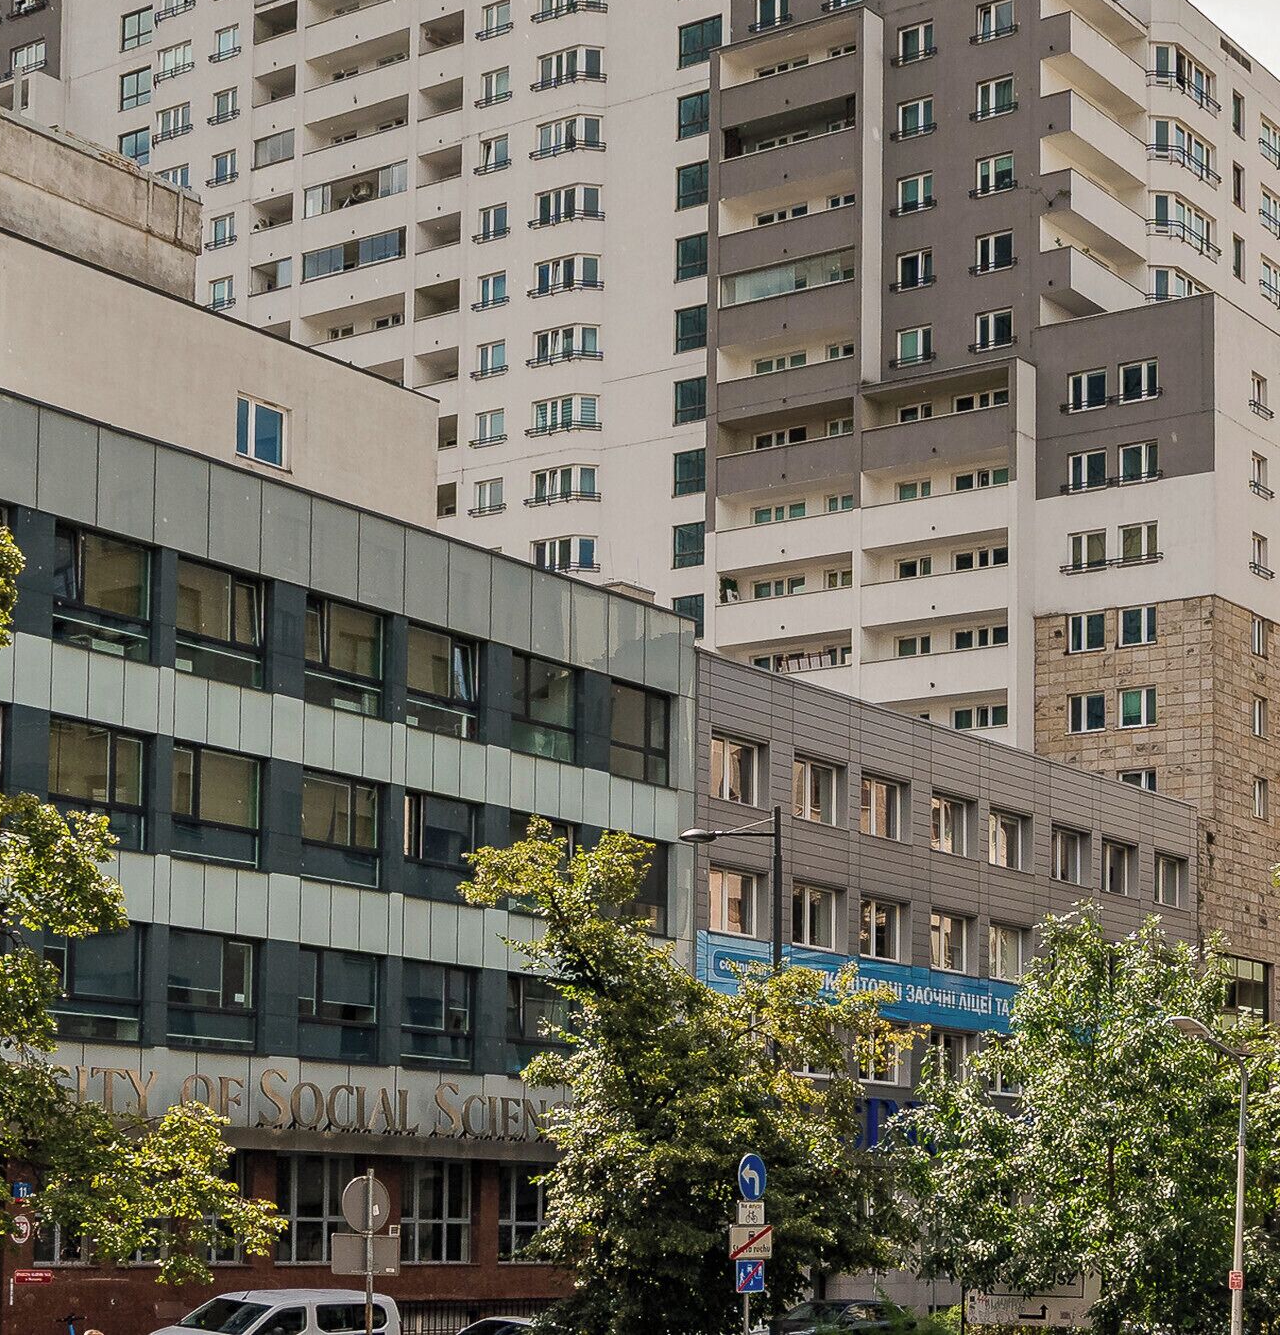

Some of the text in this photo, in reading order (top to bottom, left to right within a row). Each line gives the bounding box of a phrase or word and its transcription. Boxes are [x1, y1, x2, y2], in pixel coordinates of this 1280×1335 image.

[958, 991, 993, 1017] ЛІЦЕЇ
[995, 997, 1009, 1017] ТА
[180, 1073, 244, 1117] OF
[19, 1187, 27, 1197] 11
